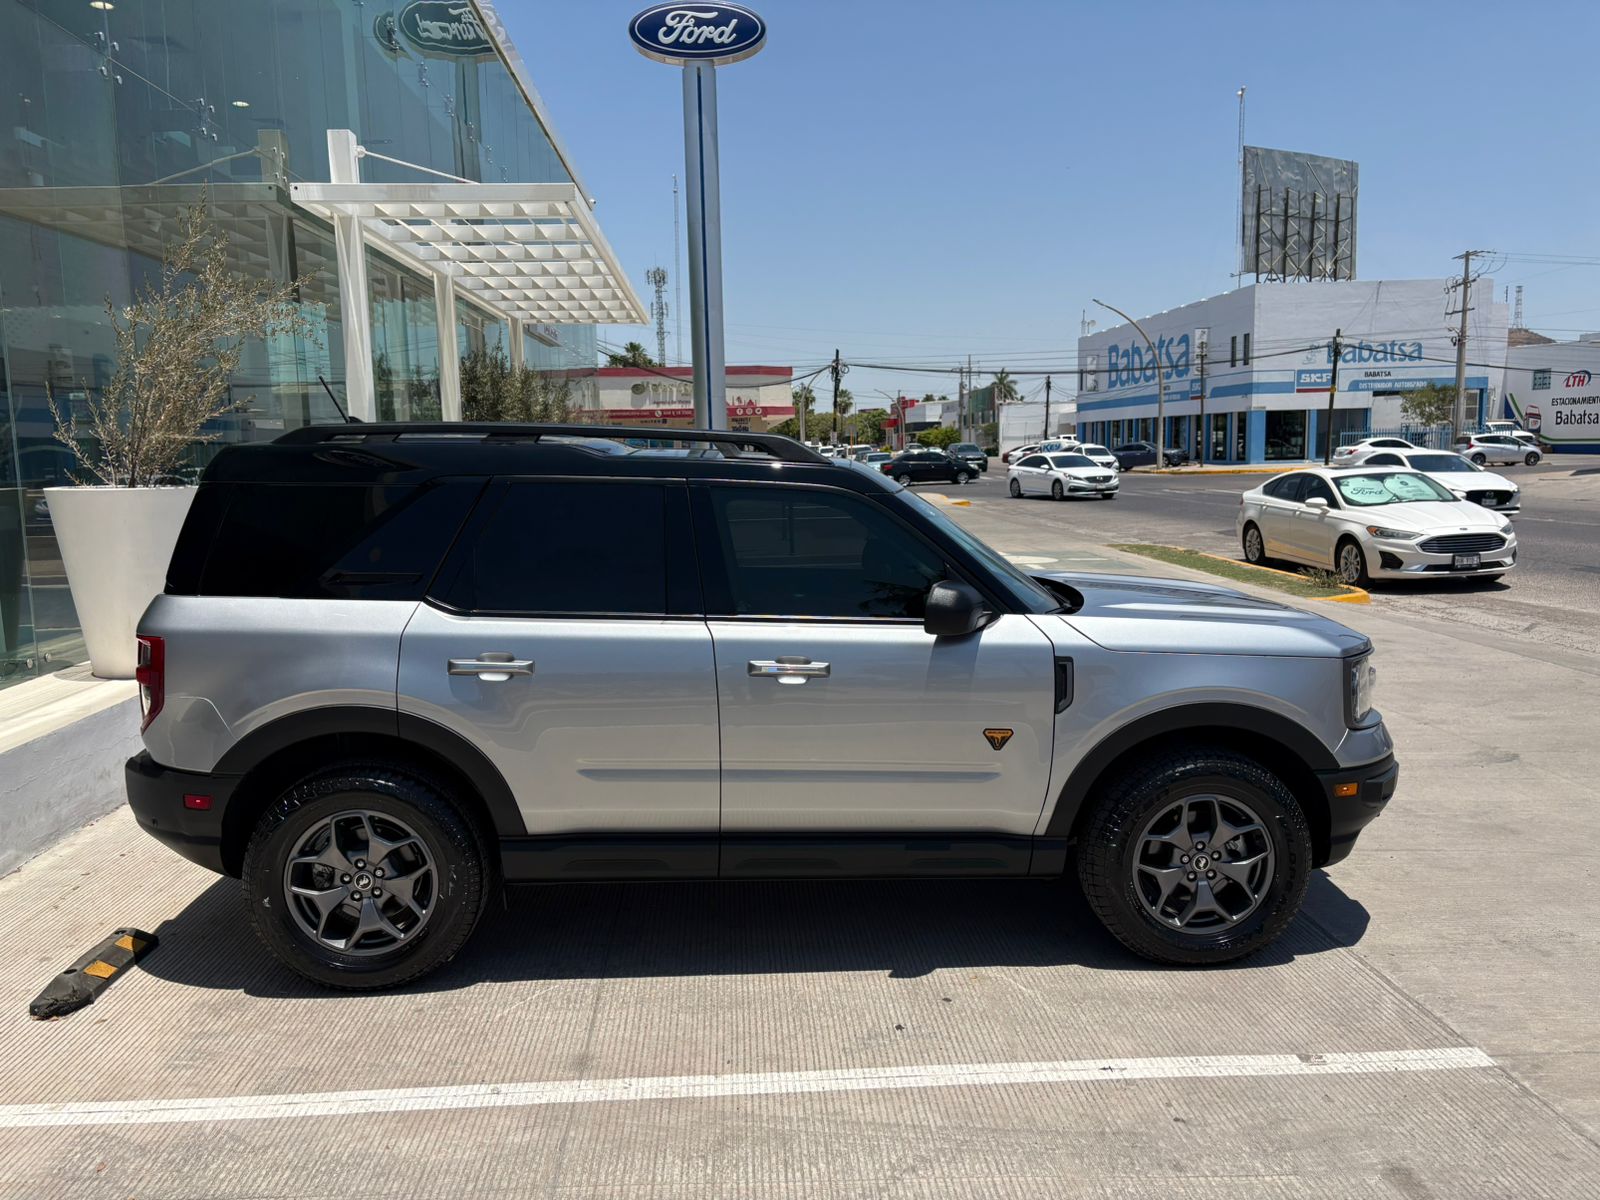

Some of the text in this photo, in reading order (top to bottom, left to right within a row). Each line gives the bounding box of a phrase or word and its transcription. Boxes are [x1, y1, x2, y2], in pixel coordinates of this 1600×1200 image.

[657, 10, 738, 44] Ford
[1108, 333, 1190, 389] Babatsa
[1300, 373, 1331, 382] SKF
[1565, 375, 1586, 388] LTH
[1555, 409, 1600, 425] Babatsa
[1350, 486, 1385, 496] Ford
